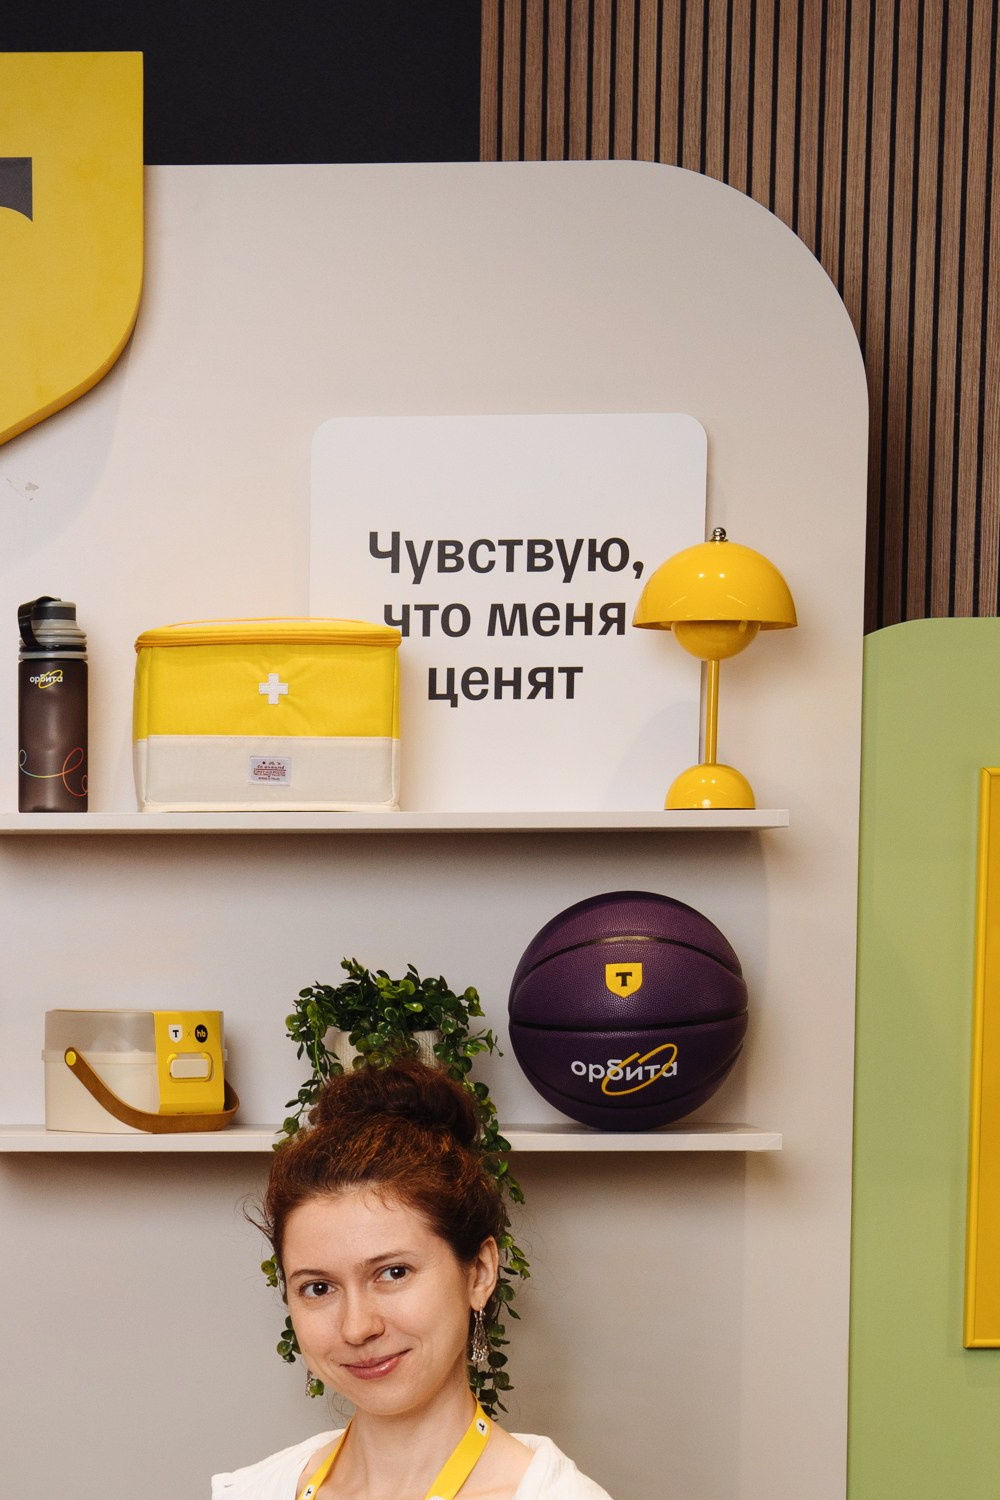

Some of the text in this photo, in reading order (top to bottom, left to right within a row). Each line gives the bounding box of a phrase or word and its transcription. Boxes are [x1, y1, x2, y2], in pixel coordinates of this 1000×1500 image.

[368, 530, 645, 585] Чувствую,
[383, 601, 627, 638] что меня
[29, 672, 63, 685] орбита
[427, 666, 584, 708] ценят
[615, 971, 633, 987] Т
[570, 1057, 678, 1084] орбита
